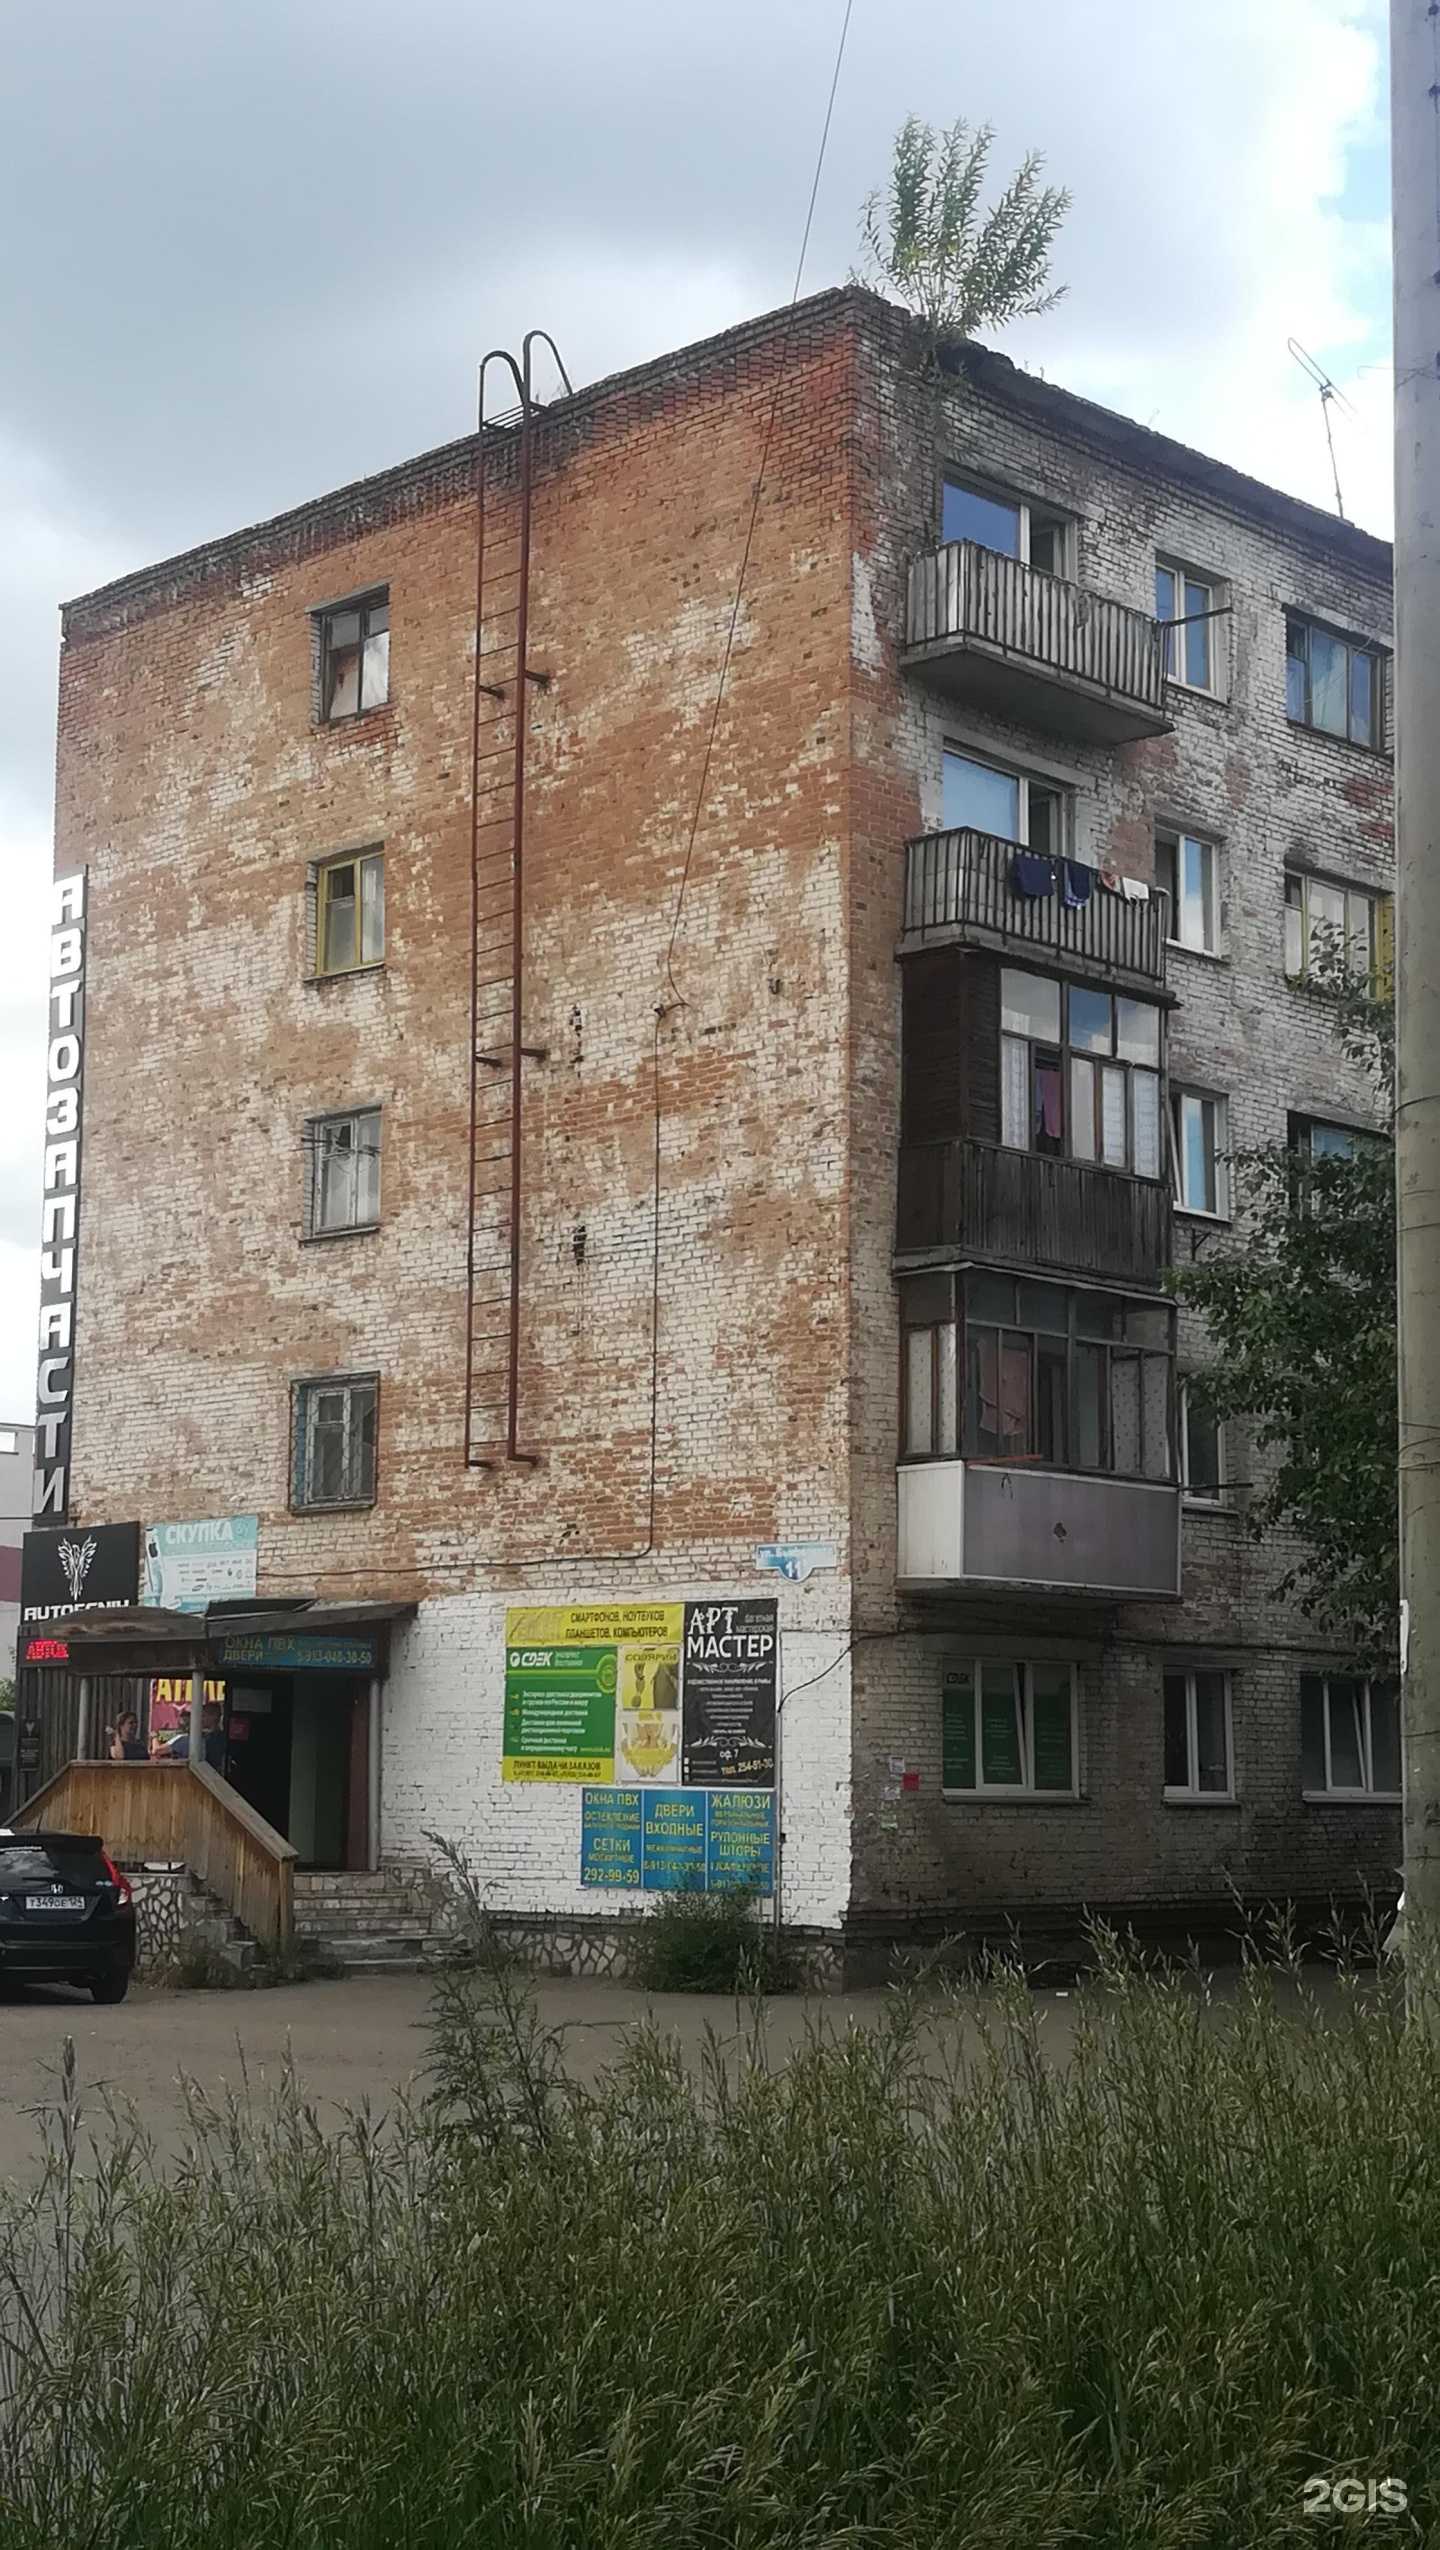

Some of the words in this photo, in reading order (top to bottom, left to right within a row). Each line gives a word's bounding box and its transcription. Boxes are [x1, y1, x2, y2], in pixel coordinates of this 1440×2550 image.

[33, 873, 86, 1516] АВТОЗАПЧАСТИ
[165, 1521, 234, 1544] СКУПКА
[688, 1607, 738, 1635] АРТ
[613, 1626, 668, 1638] КОМПЬЮТЕРОВ
[688, 1635, 773, 1658] МАСТЕР
[585, 1792, 614, 1804] ОКНА
[616, 1793, 639, 1806] ПВХ
[712, 1794, 770, 1808] ЖАЛЮЗИ
[655, 1804, 695, 1818] ДВЕРИ
[646, 1823, 704, 1836] ВХОДНЫЕ
[593, 1838, 630, 1851] СЕТКИ
[711, 1831, 770, 1845] РУЛОННЫЕ
[720, 1844, 761, 1857] ШТОРЫ
